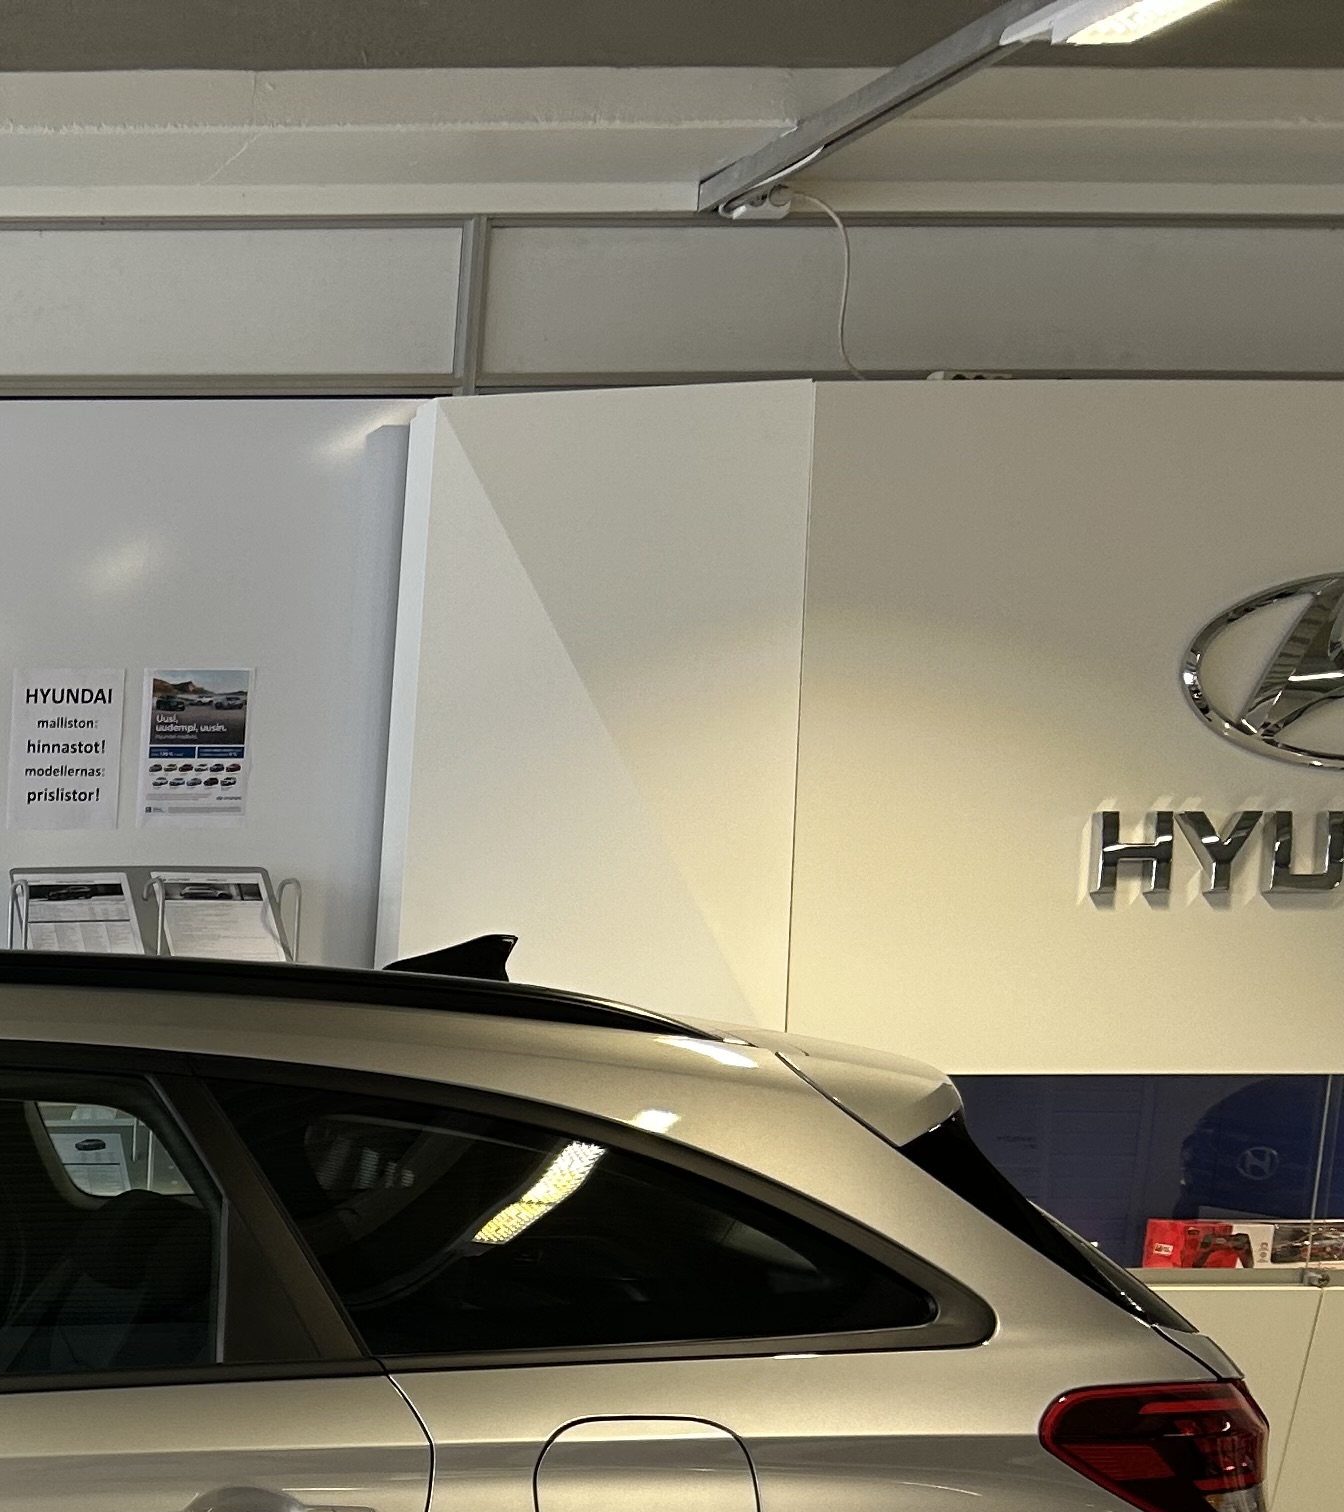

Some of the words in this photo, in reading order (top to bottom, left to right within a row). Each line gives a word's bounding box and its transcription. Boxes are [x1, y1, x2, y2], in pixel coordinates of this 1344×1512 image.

[25, 688, 113, 704] HYUNDAI
[26, 739, 106, 754] hinnastot!
[26, 787, 101, 805] prislistor!
[1089, 810, 1344, 897] HYU
